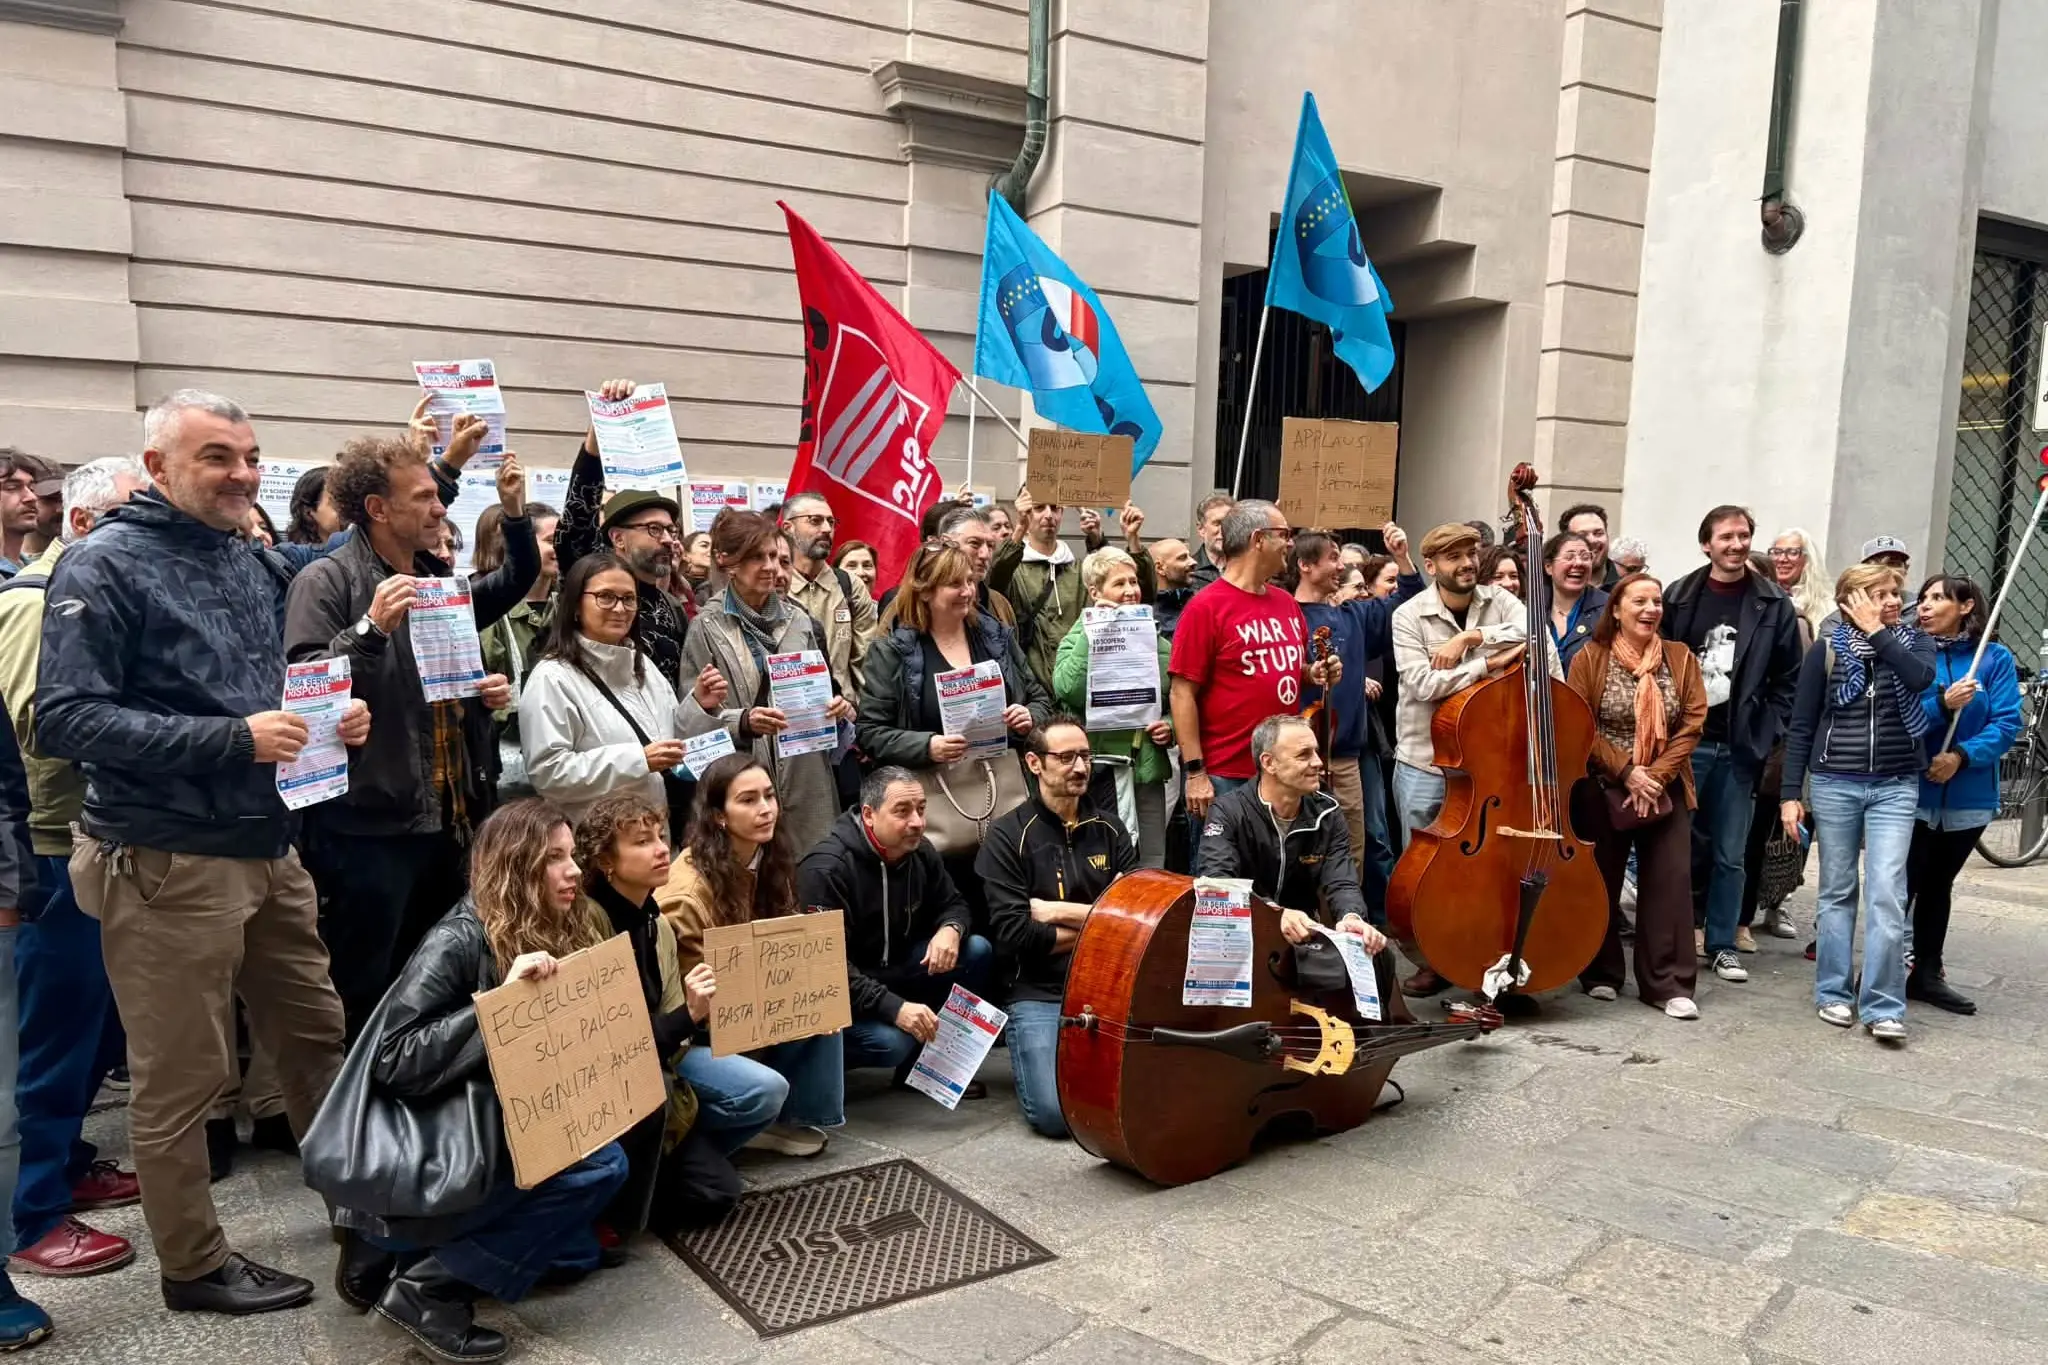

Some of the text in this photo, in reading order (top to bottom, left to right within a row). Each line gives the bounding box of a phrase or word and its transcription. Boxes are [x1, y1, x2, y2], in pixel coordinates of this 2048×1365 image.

[1293, 428, 1372, 450] APPLAUSI
[1292, 460, 1345, 477] A FINE
[1236, 617, 1288, 646] WAR
[288, 674, 341, 689] ORA SERVONO
[772, 667, 807, 679] RISPOSTE
[287, 683, 331, 698] RISPOSTE
[943, 683, 980, 696] RISPOSTE
[1196, 906, 1233, 916] RISPOSTE
[714, 937, 833, 974] LA PASSIONE
[765, 967, 796, 990] NON
[492, 957, 625, 1047] ECCELLENZA
[718, 984, 840, 1030] BASTA PER PAGARE
[535, 1002, 633, 1062] SUL PALCO,
[610, 1036, 651, 1076] ANCHE
[563, 1099, 617, 1152] FUORI
[759, 1229, 840, 1264] SIP
